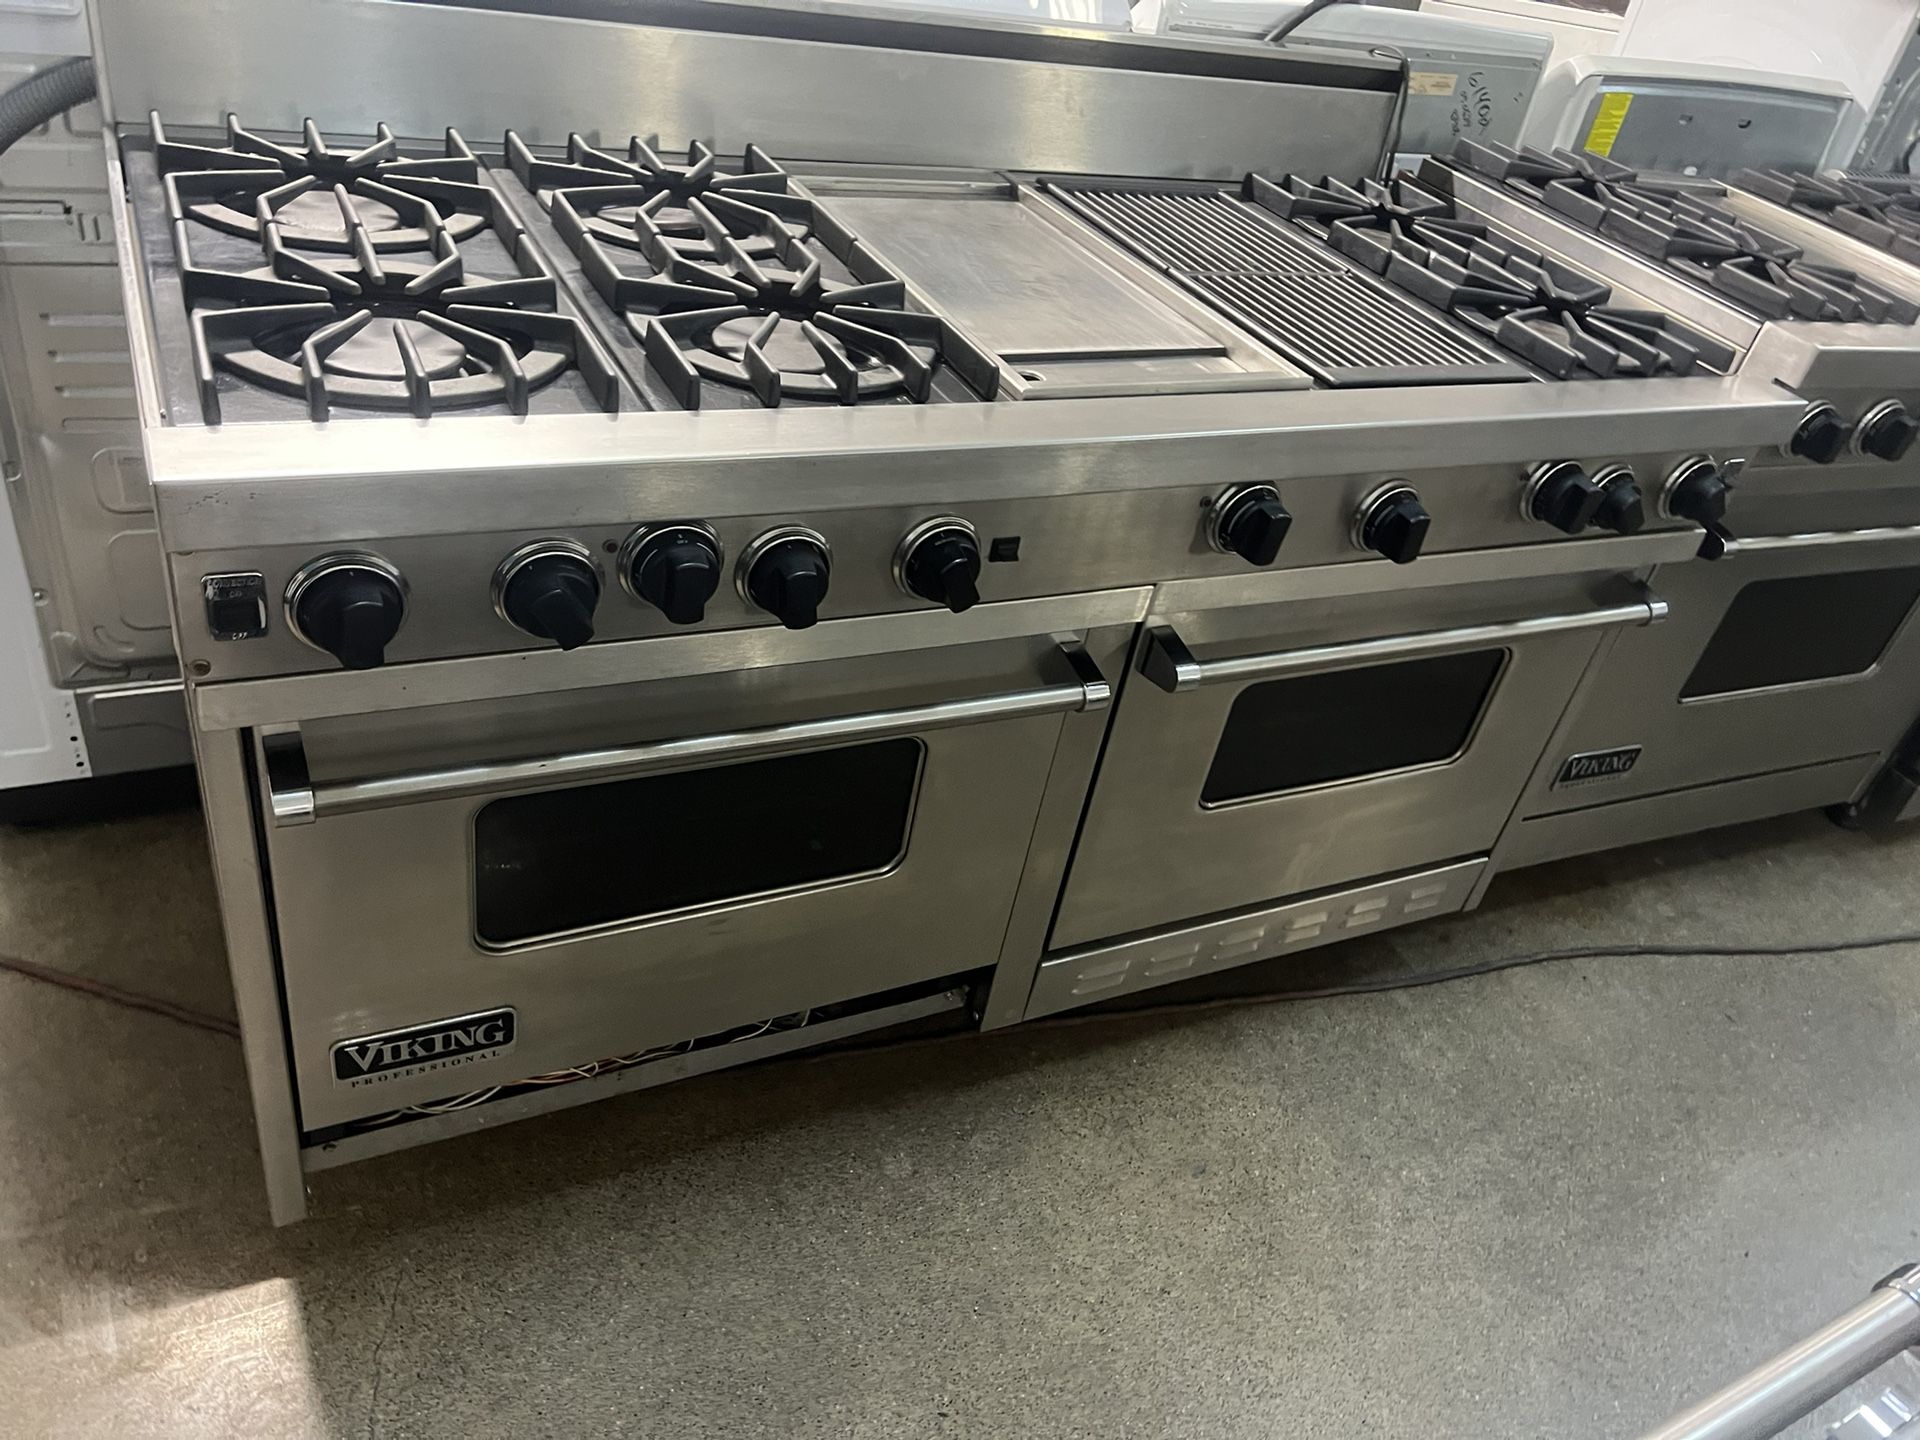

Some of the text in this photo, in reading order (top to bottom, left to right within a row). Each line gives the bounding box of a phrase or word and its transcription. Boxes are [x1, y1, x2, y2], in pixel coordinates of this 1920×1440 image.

[1570, 751, 1637, 780] VIKING
[344, 1018, 506, 1072] VIKING
[351, 1051, 501, 1089] PROFESSIONAL
